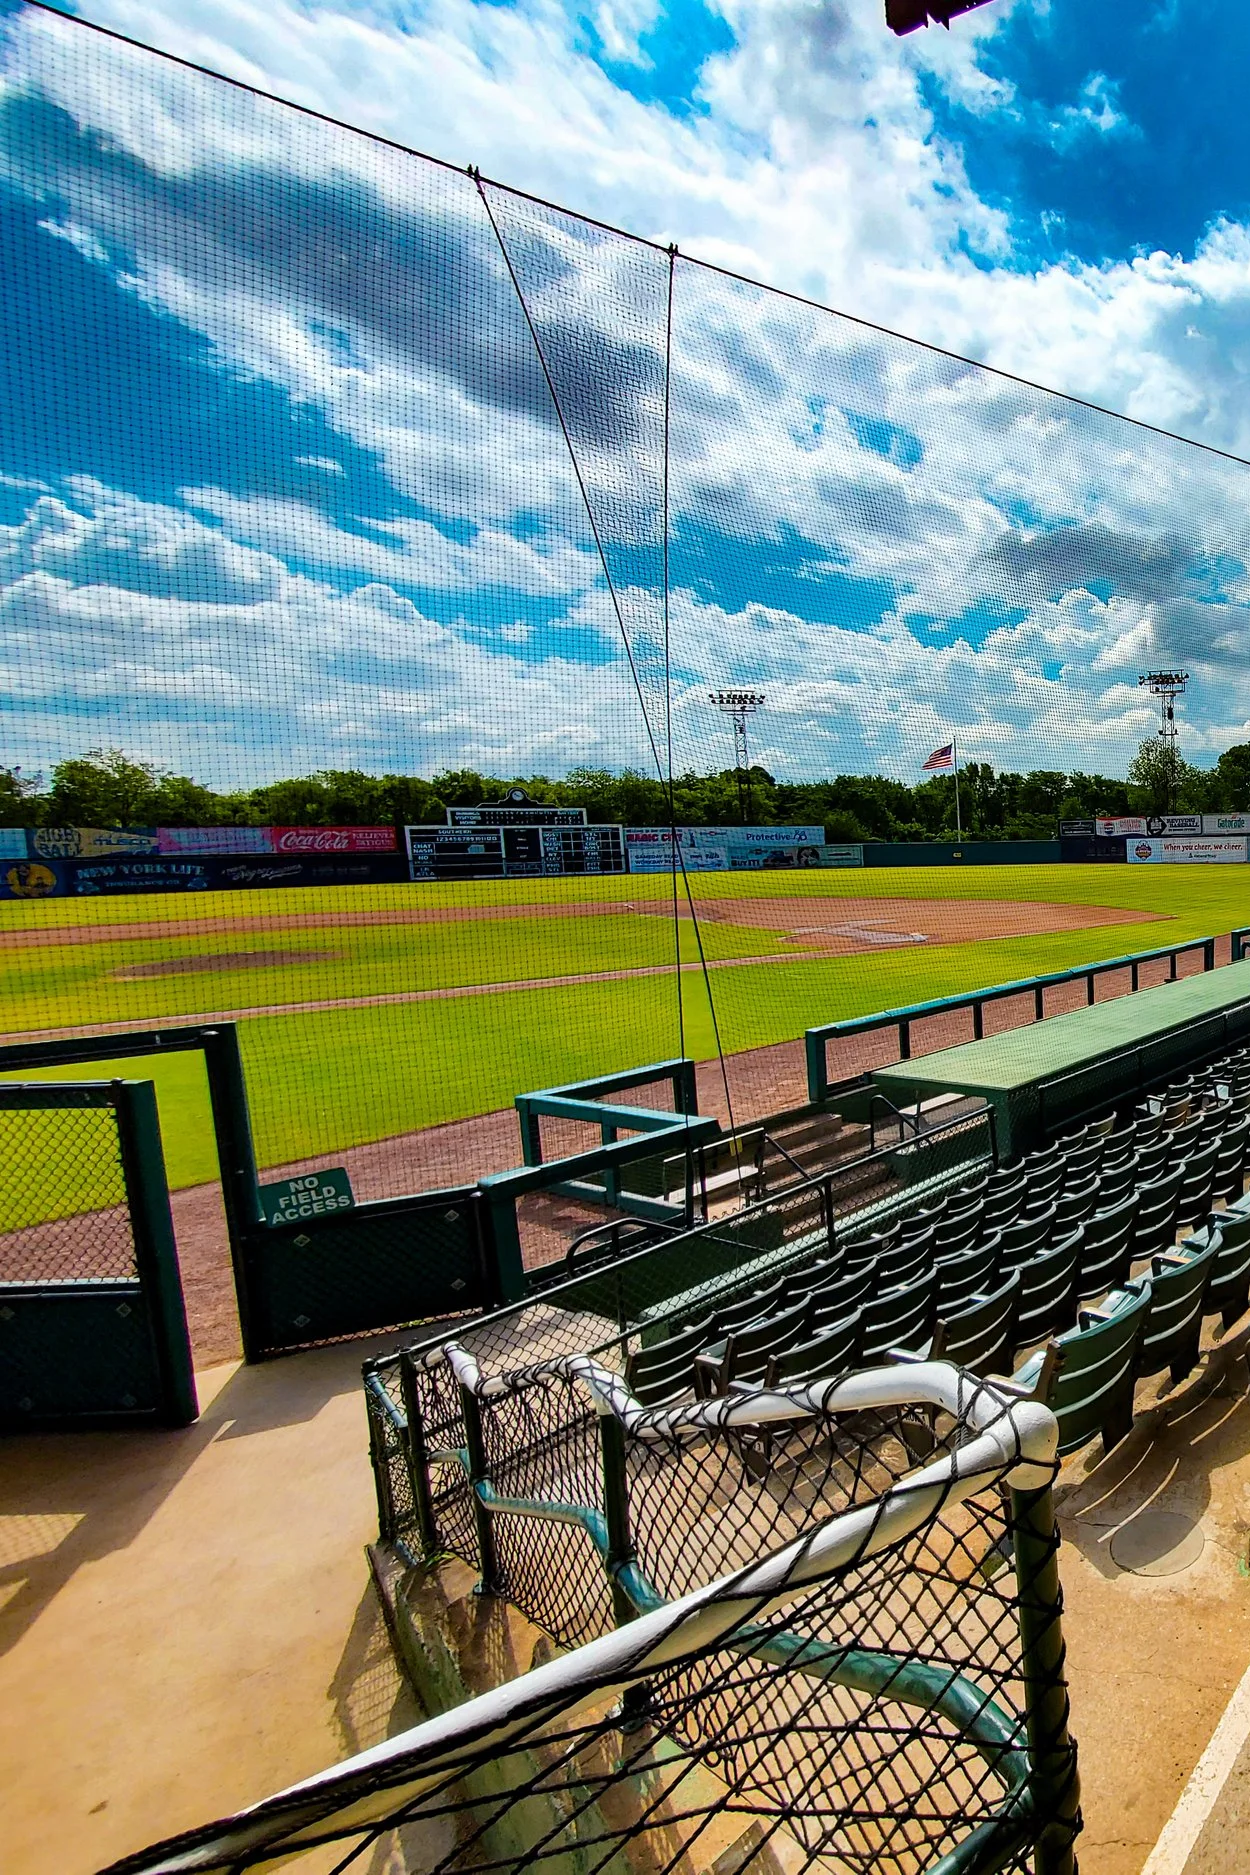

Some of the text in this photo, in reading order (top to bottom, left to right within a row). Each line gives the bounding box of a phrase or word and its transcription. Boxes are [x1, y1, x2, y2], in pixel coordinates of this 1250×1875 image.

[1217, 818, 1245, 829] Gatorade
[280, 831, 352, 850] Coca-Cola
[746, 833, 791, 841] Protective
[1163, 843, 1181, 851] When
[1194, 843, 1212, 851] cheer,
[76, 866, 117, 880] NEW
[118, 863, 168, 875] YORK
[169, 863, 206, 877] LIFE
[289, 1177, 319, 1193] NO
[279, 1186, 336, 1209] FIELD
[271, 1195, 351, 1225] ACCESS
